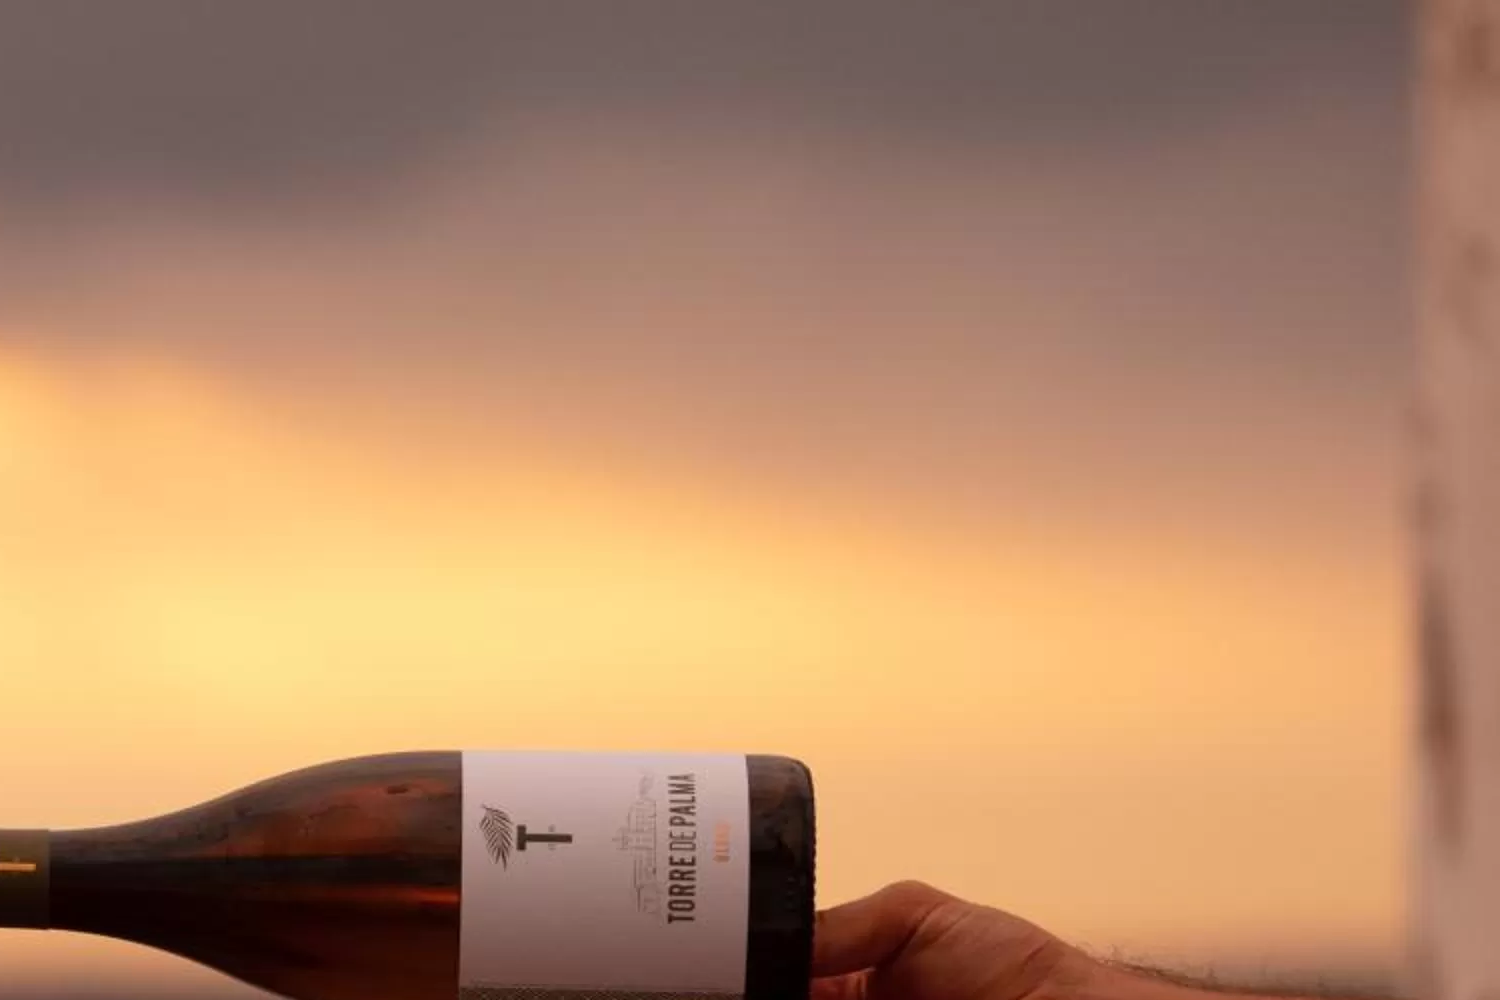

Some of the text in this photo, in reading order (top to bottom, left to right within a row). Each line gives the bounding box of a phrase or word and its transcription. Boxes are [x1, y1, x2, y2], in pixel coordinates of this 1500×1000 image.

[667, 773, 696, 925] TORRE DE PALMA
